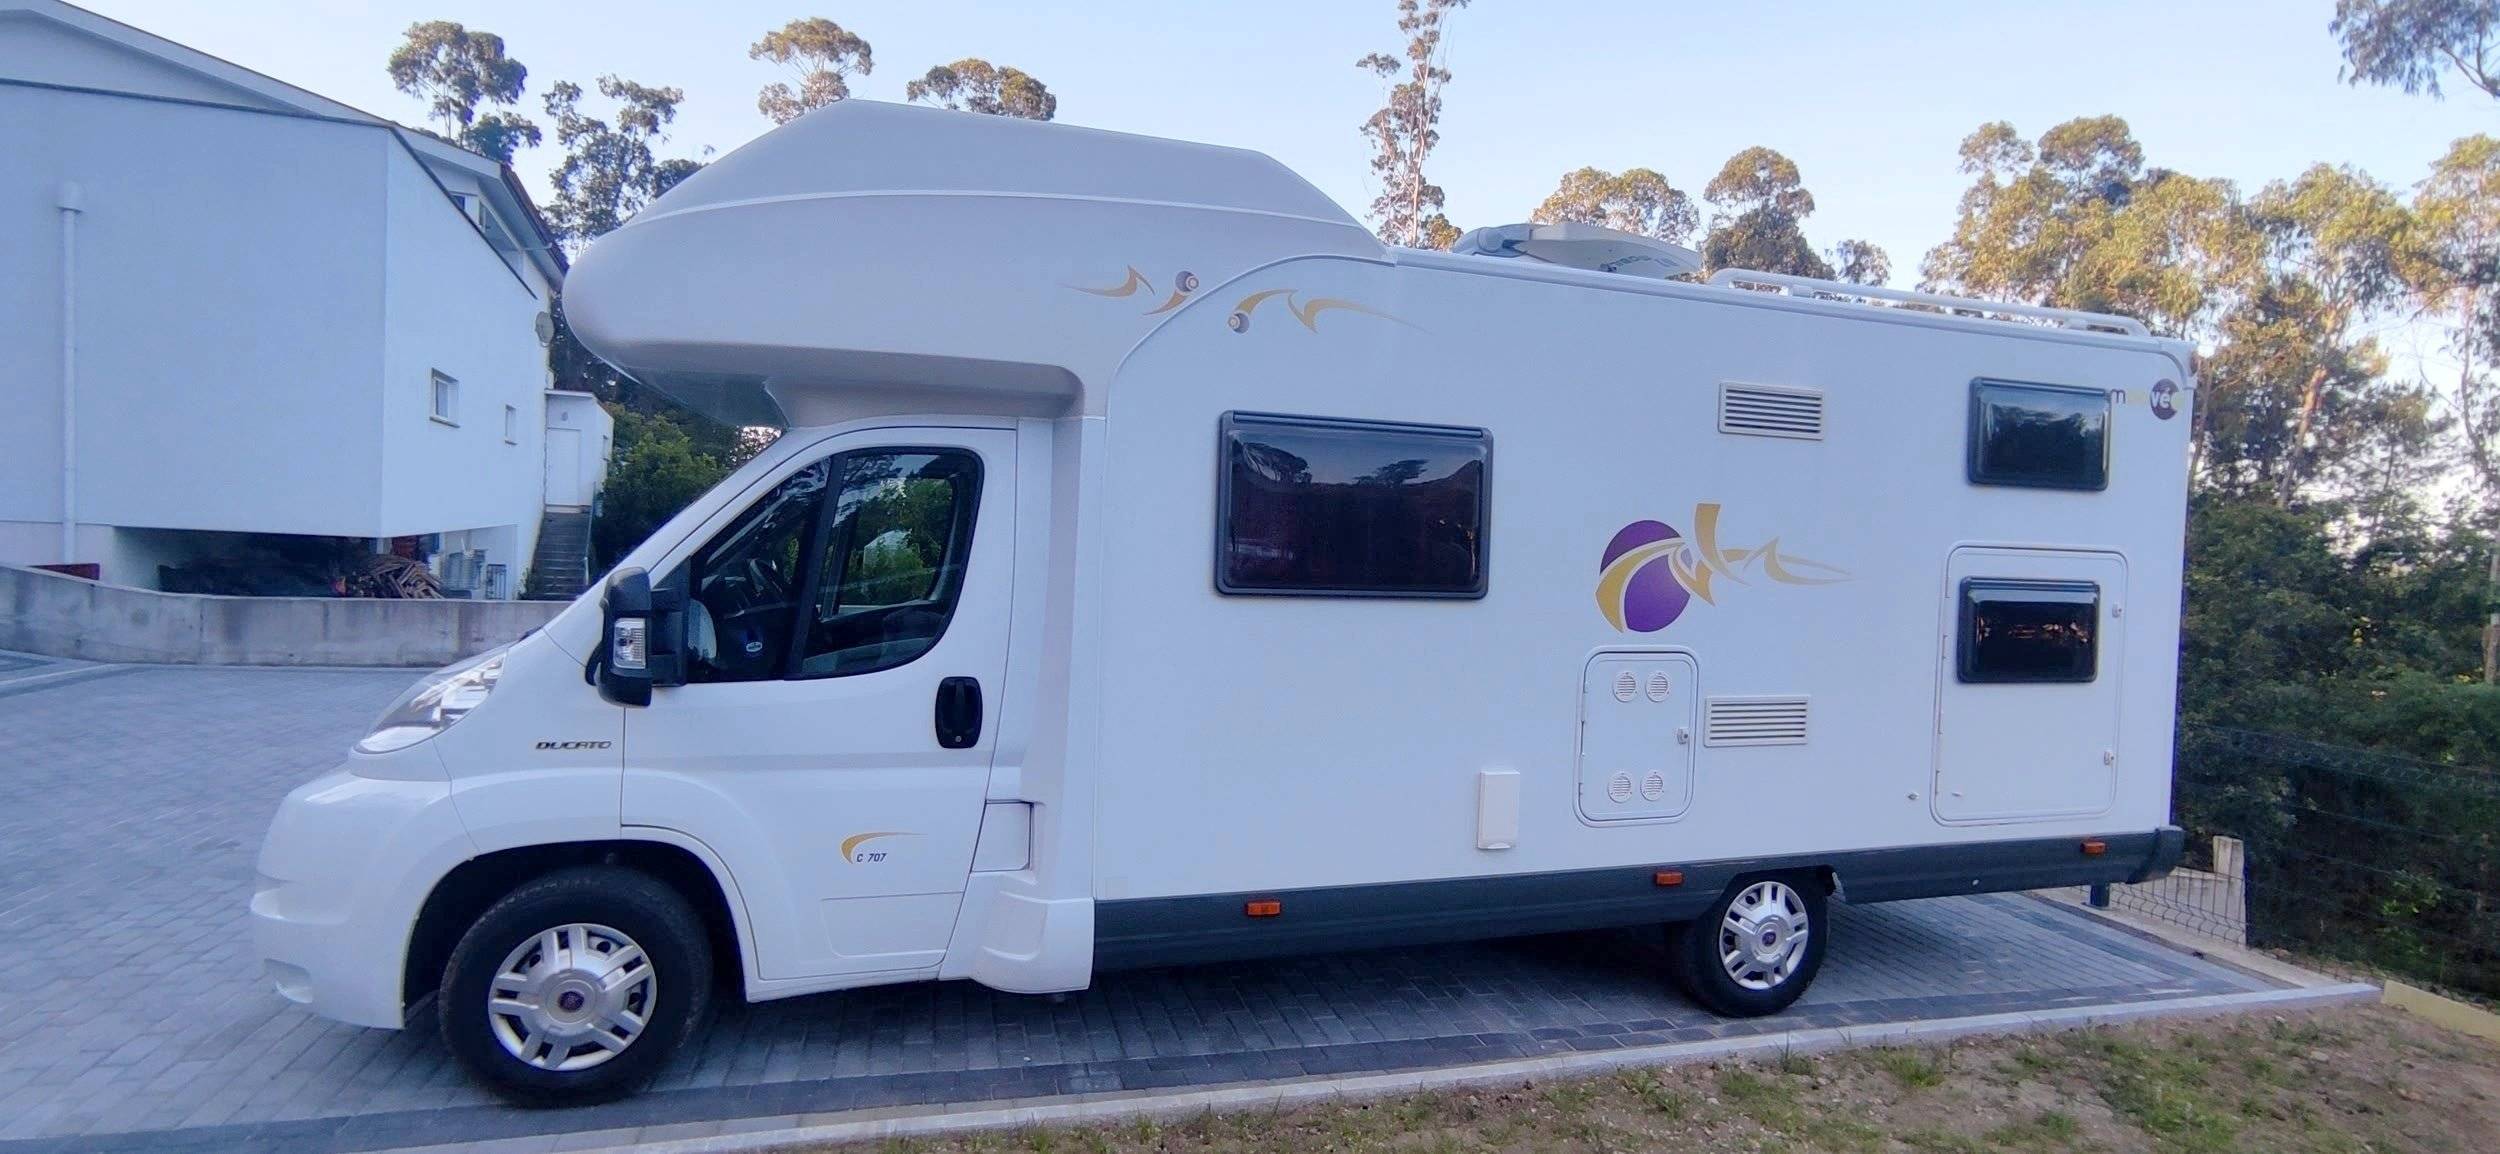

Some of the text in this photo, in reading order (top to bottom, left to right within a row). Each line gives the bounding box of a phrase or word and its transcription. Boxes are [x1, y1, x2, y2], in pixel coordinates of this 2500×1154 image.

[535, 740, 613, 750] DUCATO
[856, 852, 888, 863] C 707
